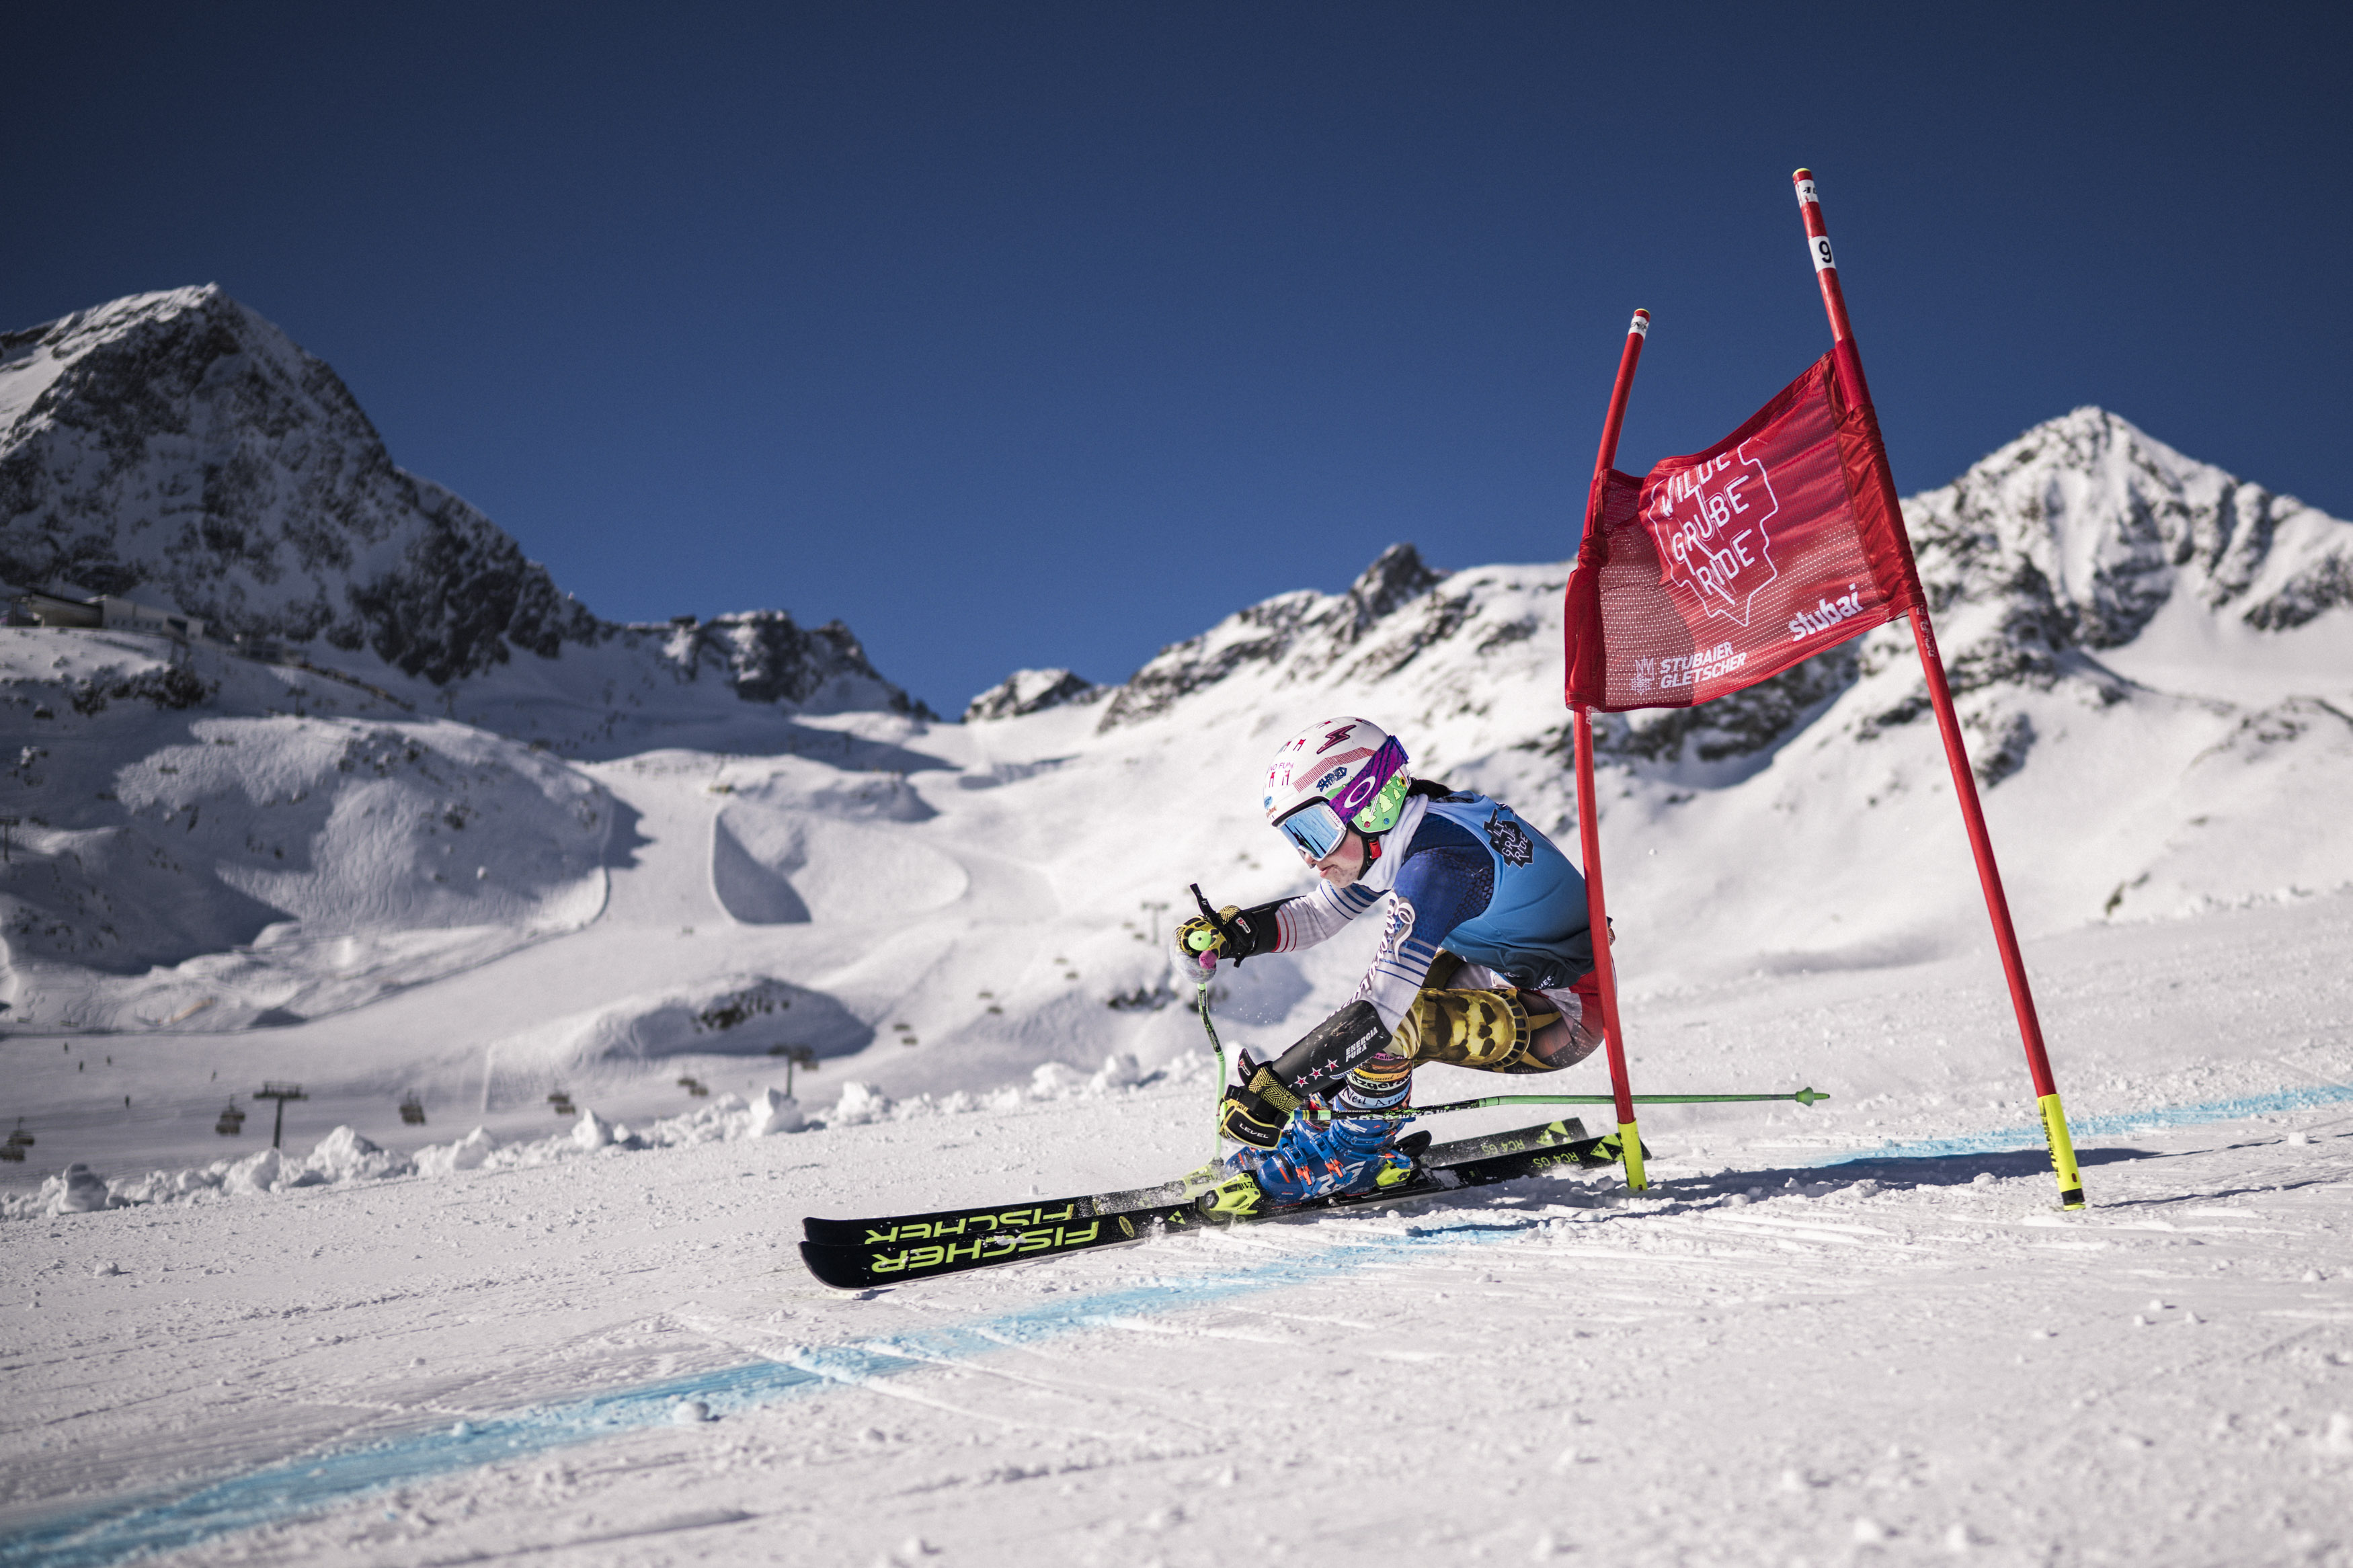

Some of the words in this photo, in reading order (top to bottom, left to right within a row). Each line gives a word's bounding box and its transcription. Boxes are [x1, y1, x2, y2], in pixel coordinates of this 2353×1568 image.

[1819, 240, 1832, 263] 9
[1661, 452, 1731, 518] WILDE
[1672, 474, 1750, 575] GRUBE
[1696, 528, 1756, 605] RIDE
[1788, 583, 1864, 642] stubai
[1660, 641, 1734, 674] STUBAIER
[1661, 652, 1747, 689] GLETSCHER
[1316, 766, 1347, 792] SHRED
[1328, 809, 1341, 824] OAKLEY
[1345, 1043, 1367, 1063] PURA
[1346, 1026, 1378, 1055] ENERGIA
[1342, 1085, 1367, 1105] Neil
[1238, 1122, 1269, 1139] LEVEL
[1482, 1144, 1499, 1155] GS
[1501, 1139, 1525, 1151] RC4
[1553, 1151, 1580, 1163] RC4
[1532, 1157, 1551, 1168] GS
[865, 1204, 1074, 1244] FISCHER
[871, 1221, 1099, 1273] FISCHER
